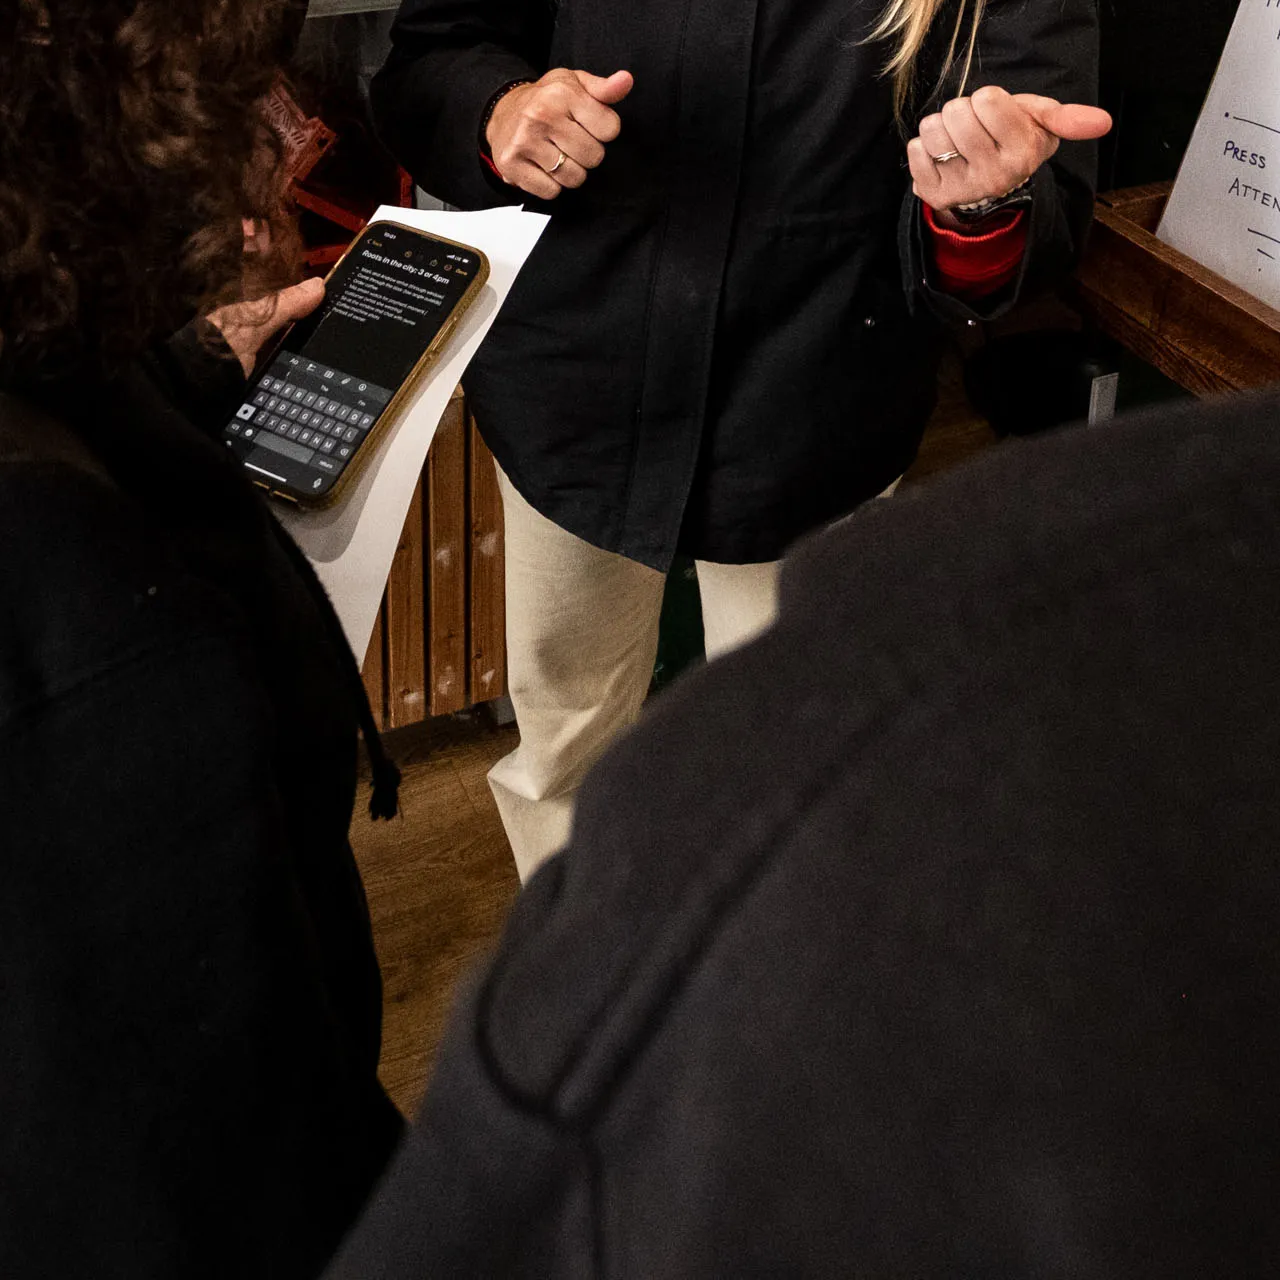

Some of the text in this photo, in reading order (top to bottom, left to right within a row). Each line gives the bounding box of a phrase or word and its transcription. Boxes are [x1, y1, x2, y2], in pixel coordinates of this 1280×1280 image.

[1223, 140, 1266, 169] PRESS
[362, 250, 382, 262] Roots
[390, 259, 402, 268] the
[418, 268, 424, 276] 3
[432, 274, 449, 284] 4pm
